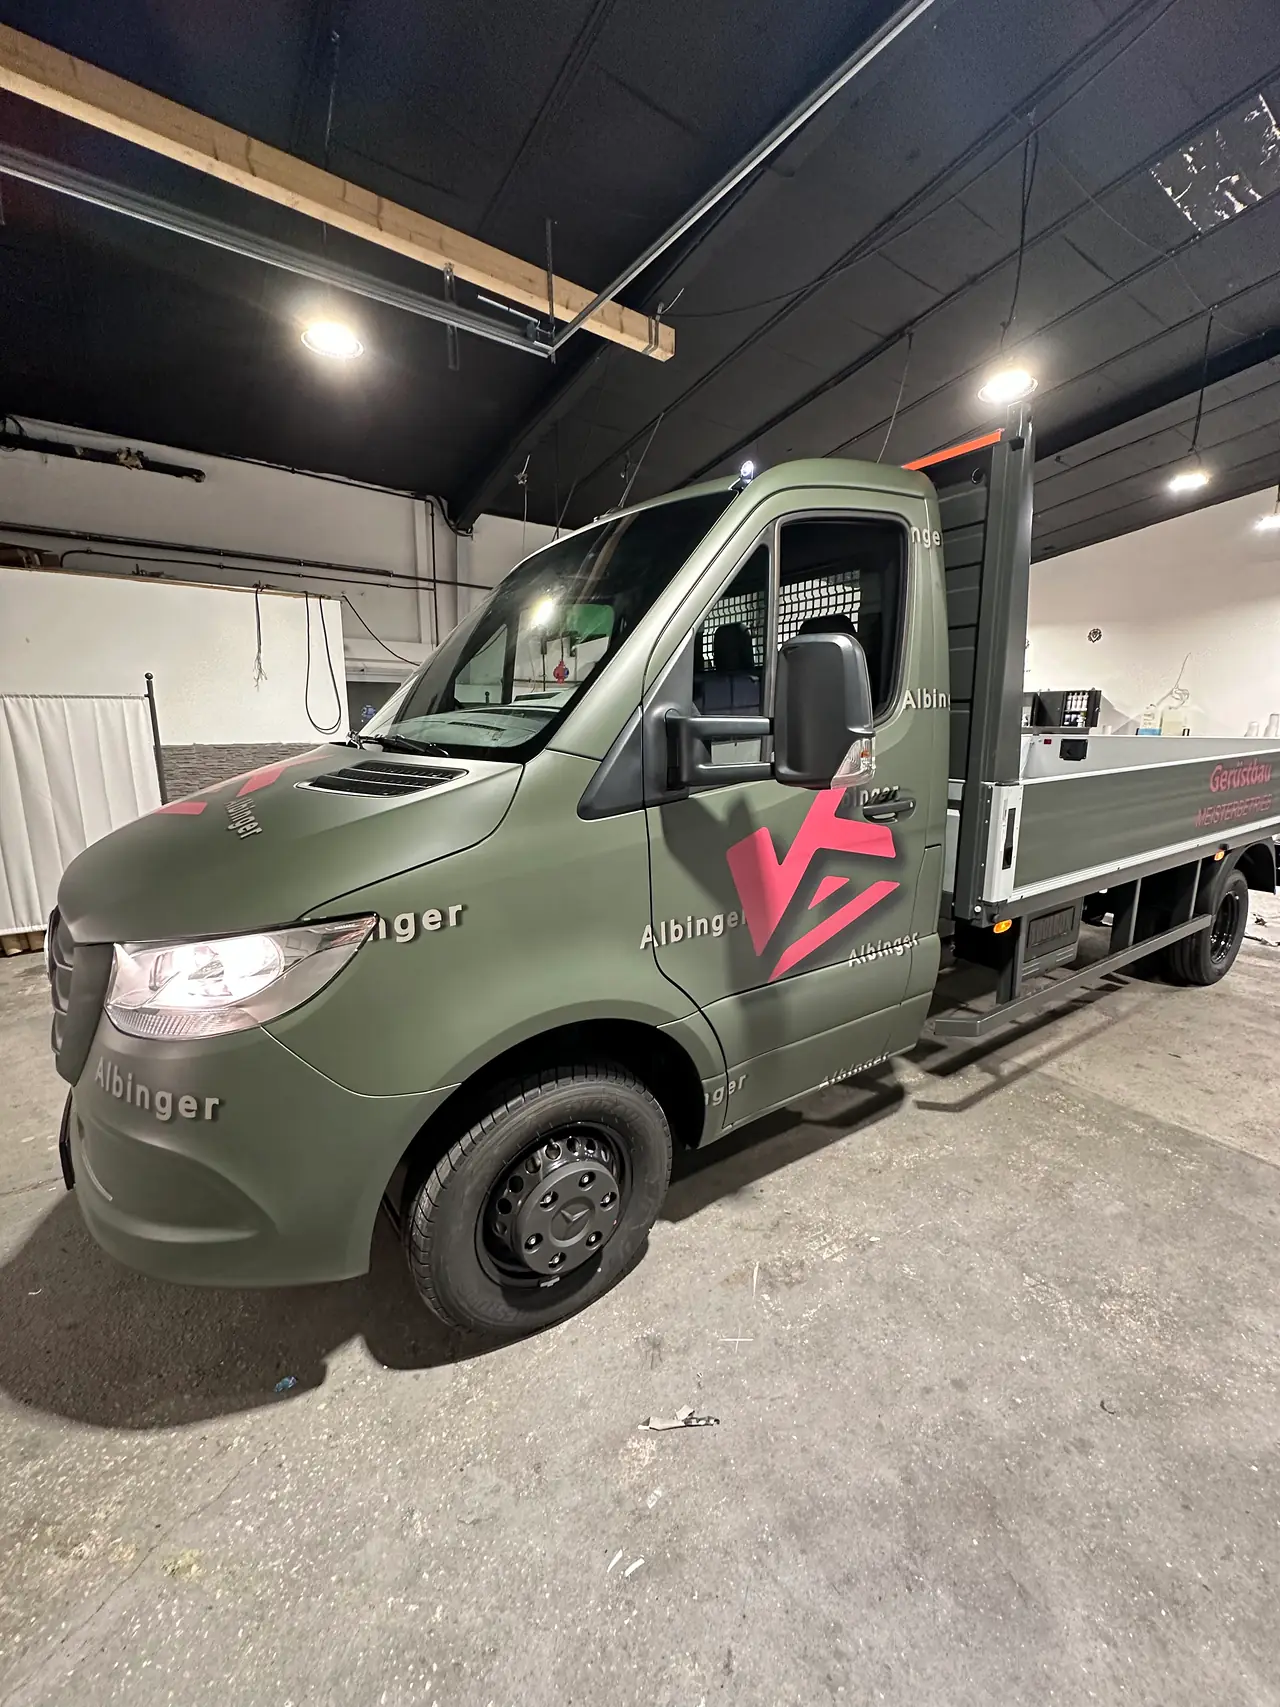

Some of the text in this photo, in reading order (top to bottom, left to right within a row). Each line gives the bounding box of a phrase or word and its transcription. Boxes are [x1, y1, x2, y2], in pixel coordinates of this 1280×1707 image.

[903, 687, 951, 711] Albin
[1210, 758, 1272, 792] Gerüstbau
[224, 796, 262, 838] Albinger
[847, 931, 919, 968] Albinger
[94, 1055, 220, 1121] Albinger
